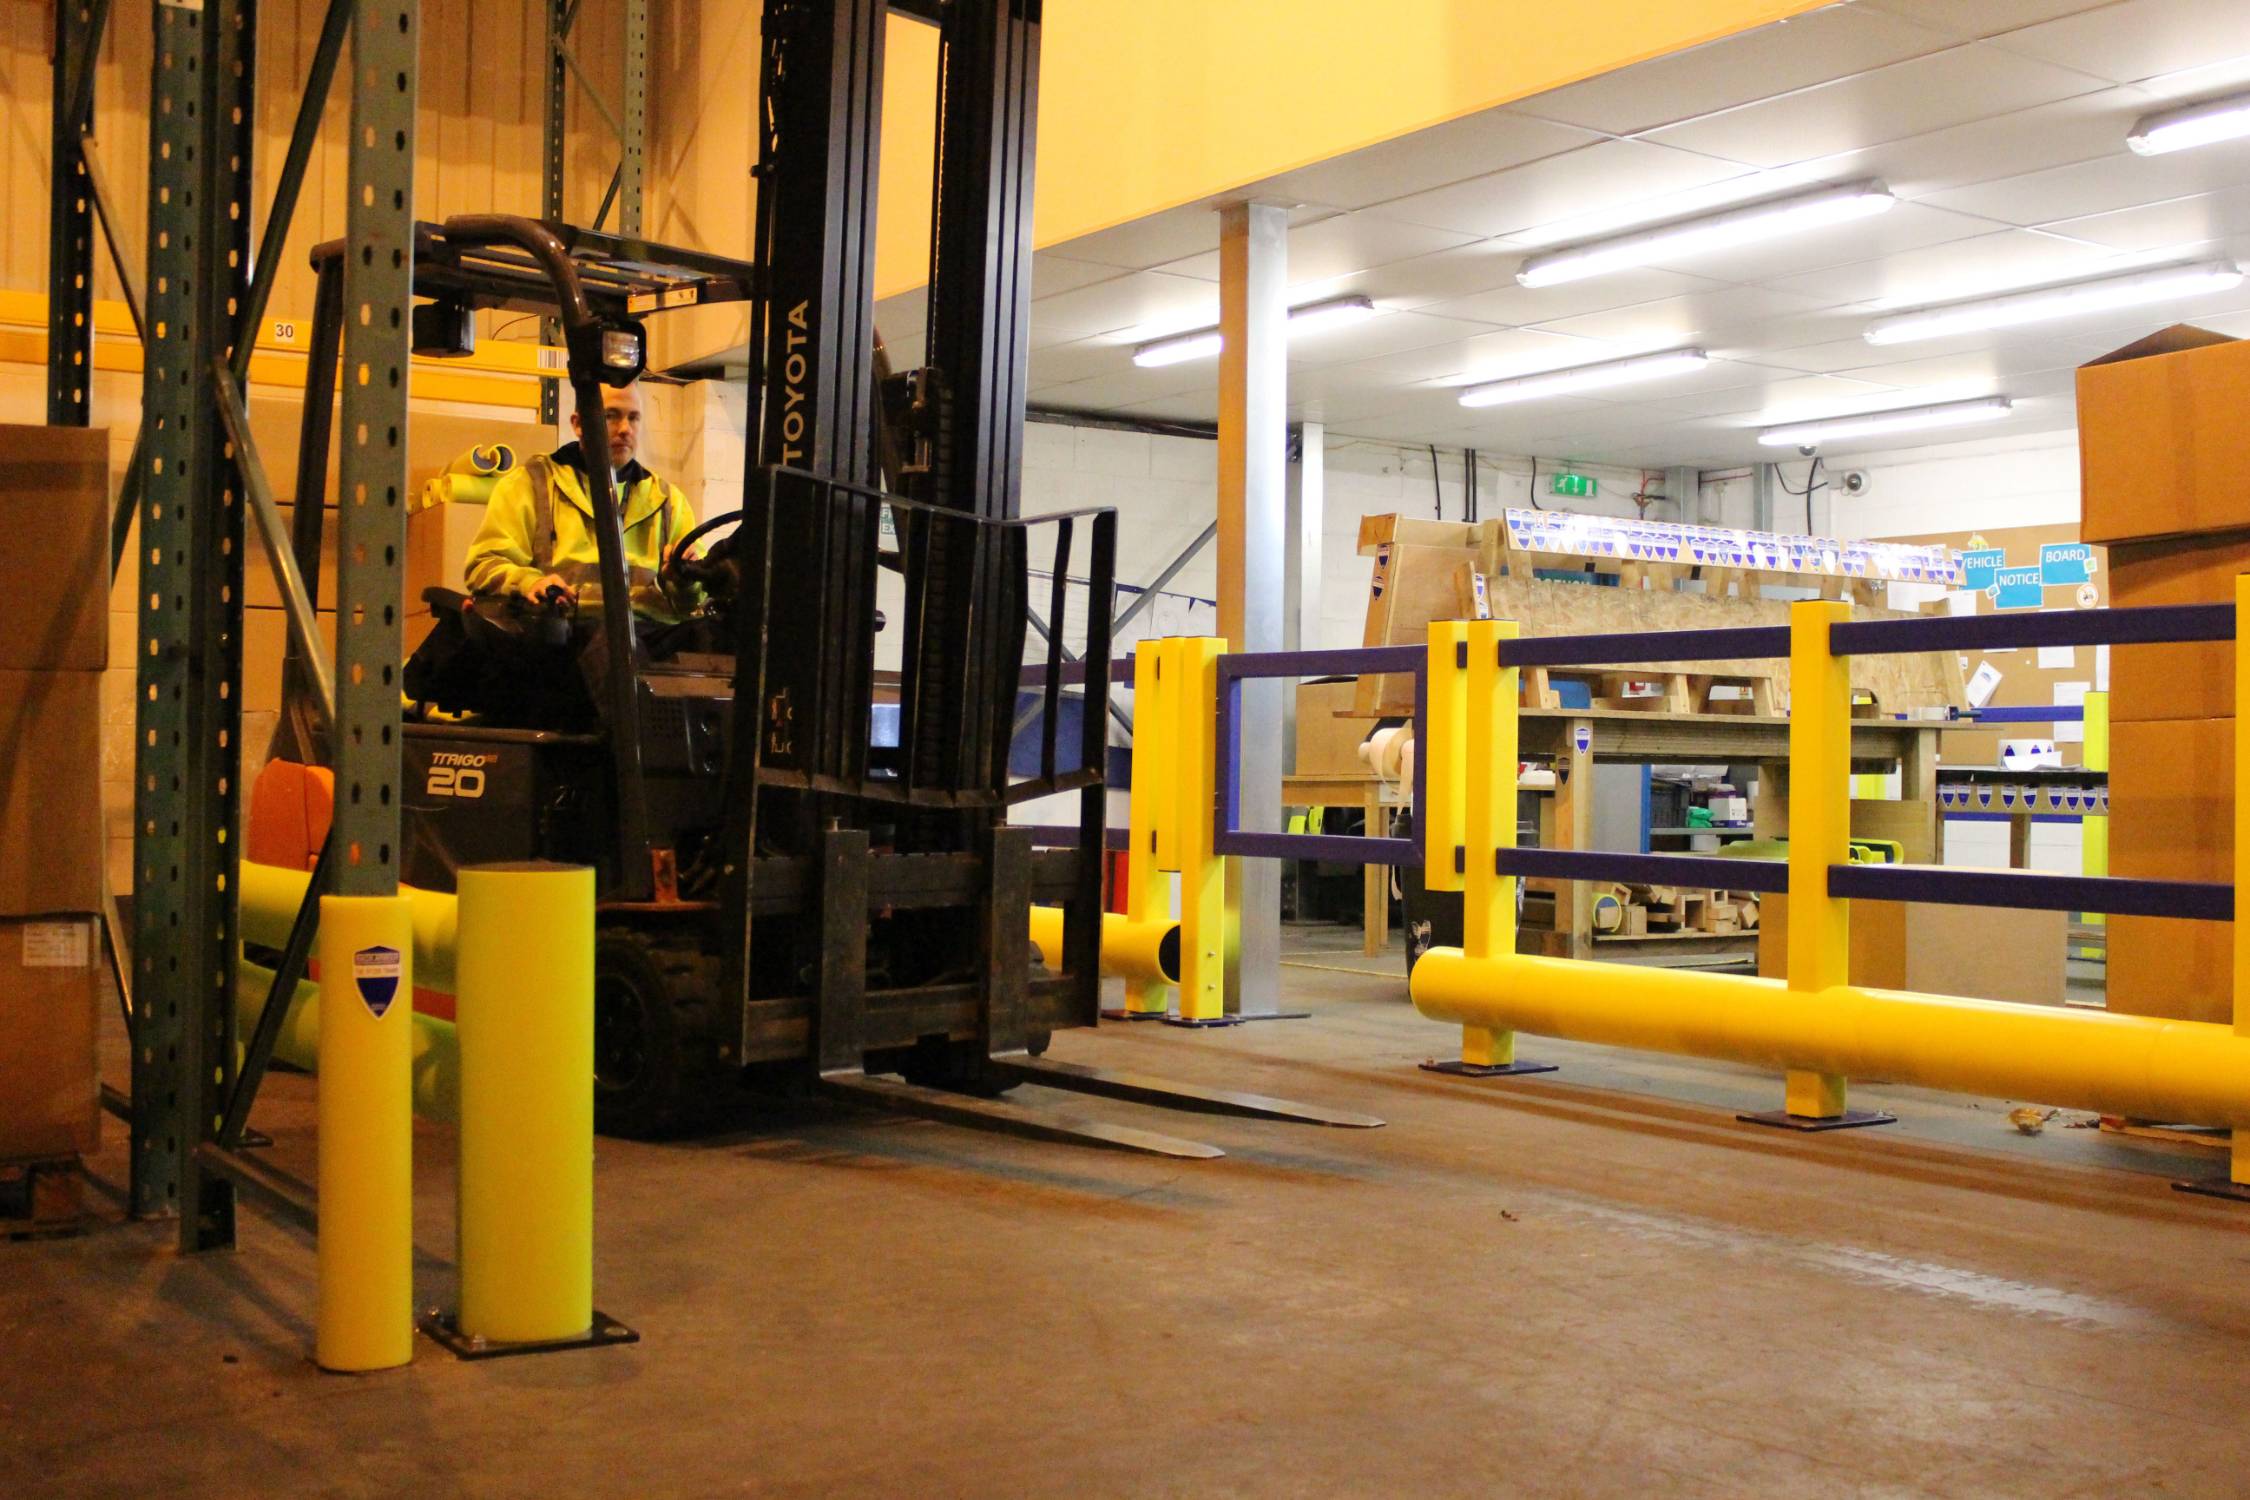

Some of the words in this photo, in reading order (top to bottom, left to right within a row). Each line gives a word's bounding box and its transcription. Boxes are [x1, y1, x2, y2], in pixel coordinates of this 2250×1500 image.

[276, 323, 294, 338] 30
[783, 299, 809, 467] TOYOTA
[2045, 548, 2086, 563] BOARD
[1999, 572, 2040, 587] NOTICE
[427, 766, 486, 799] 20
